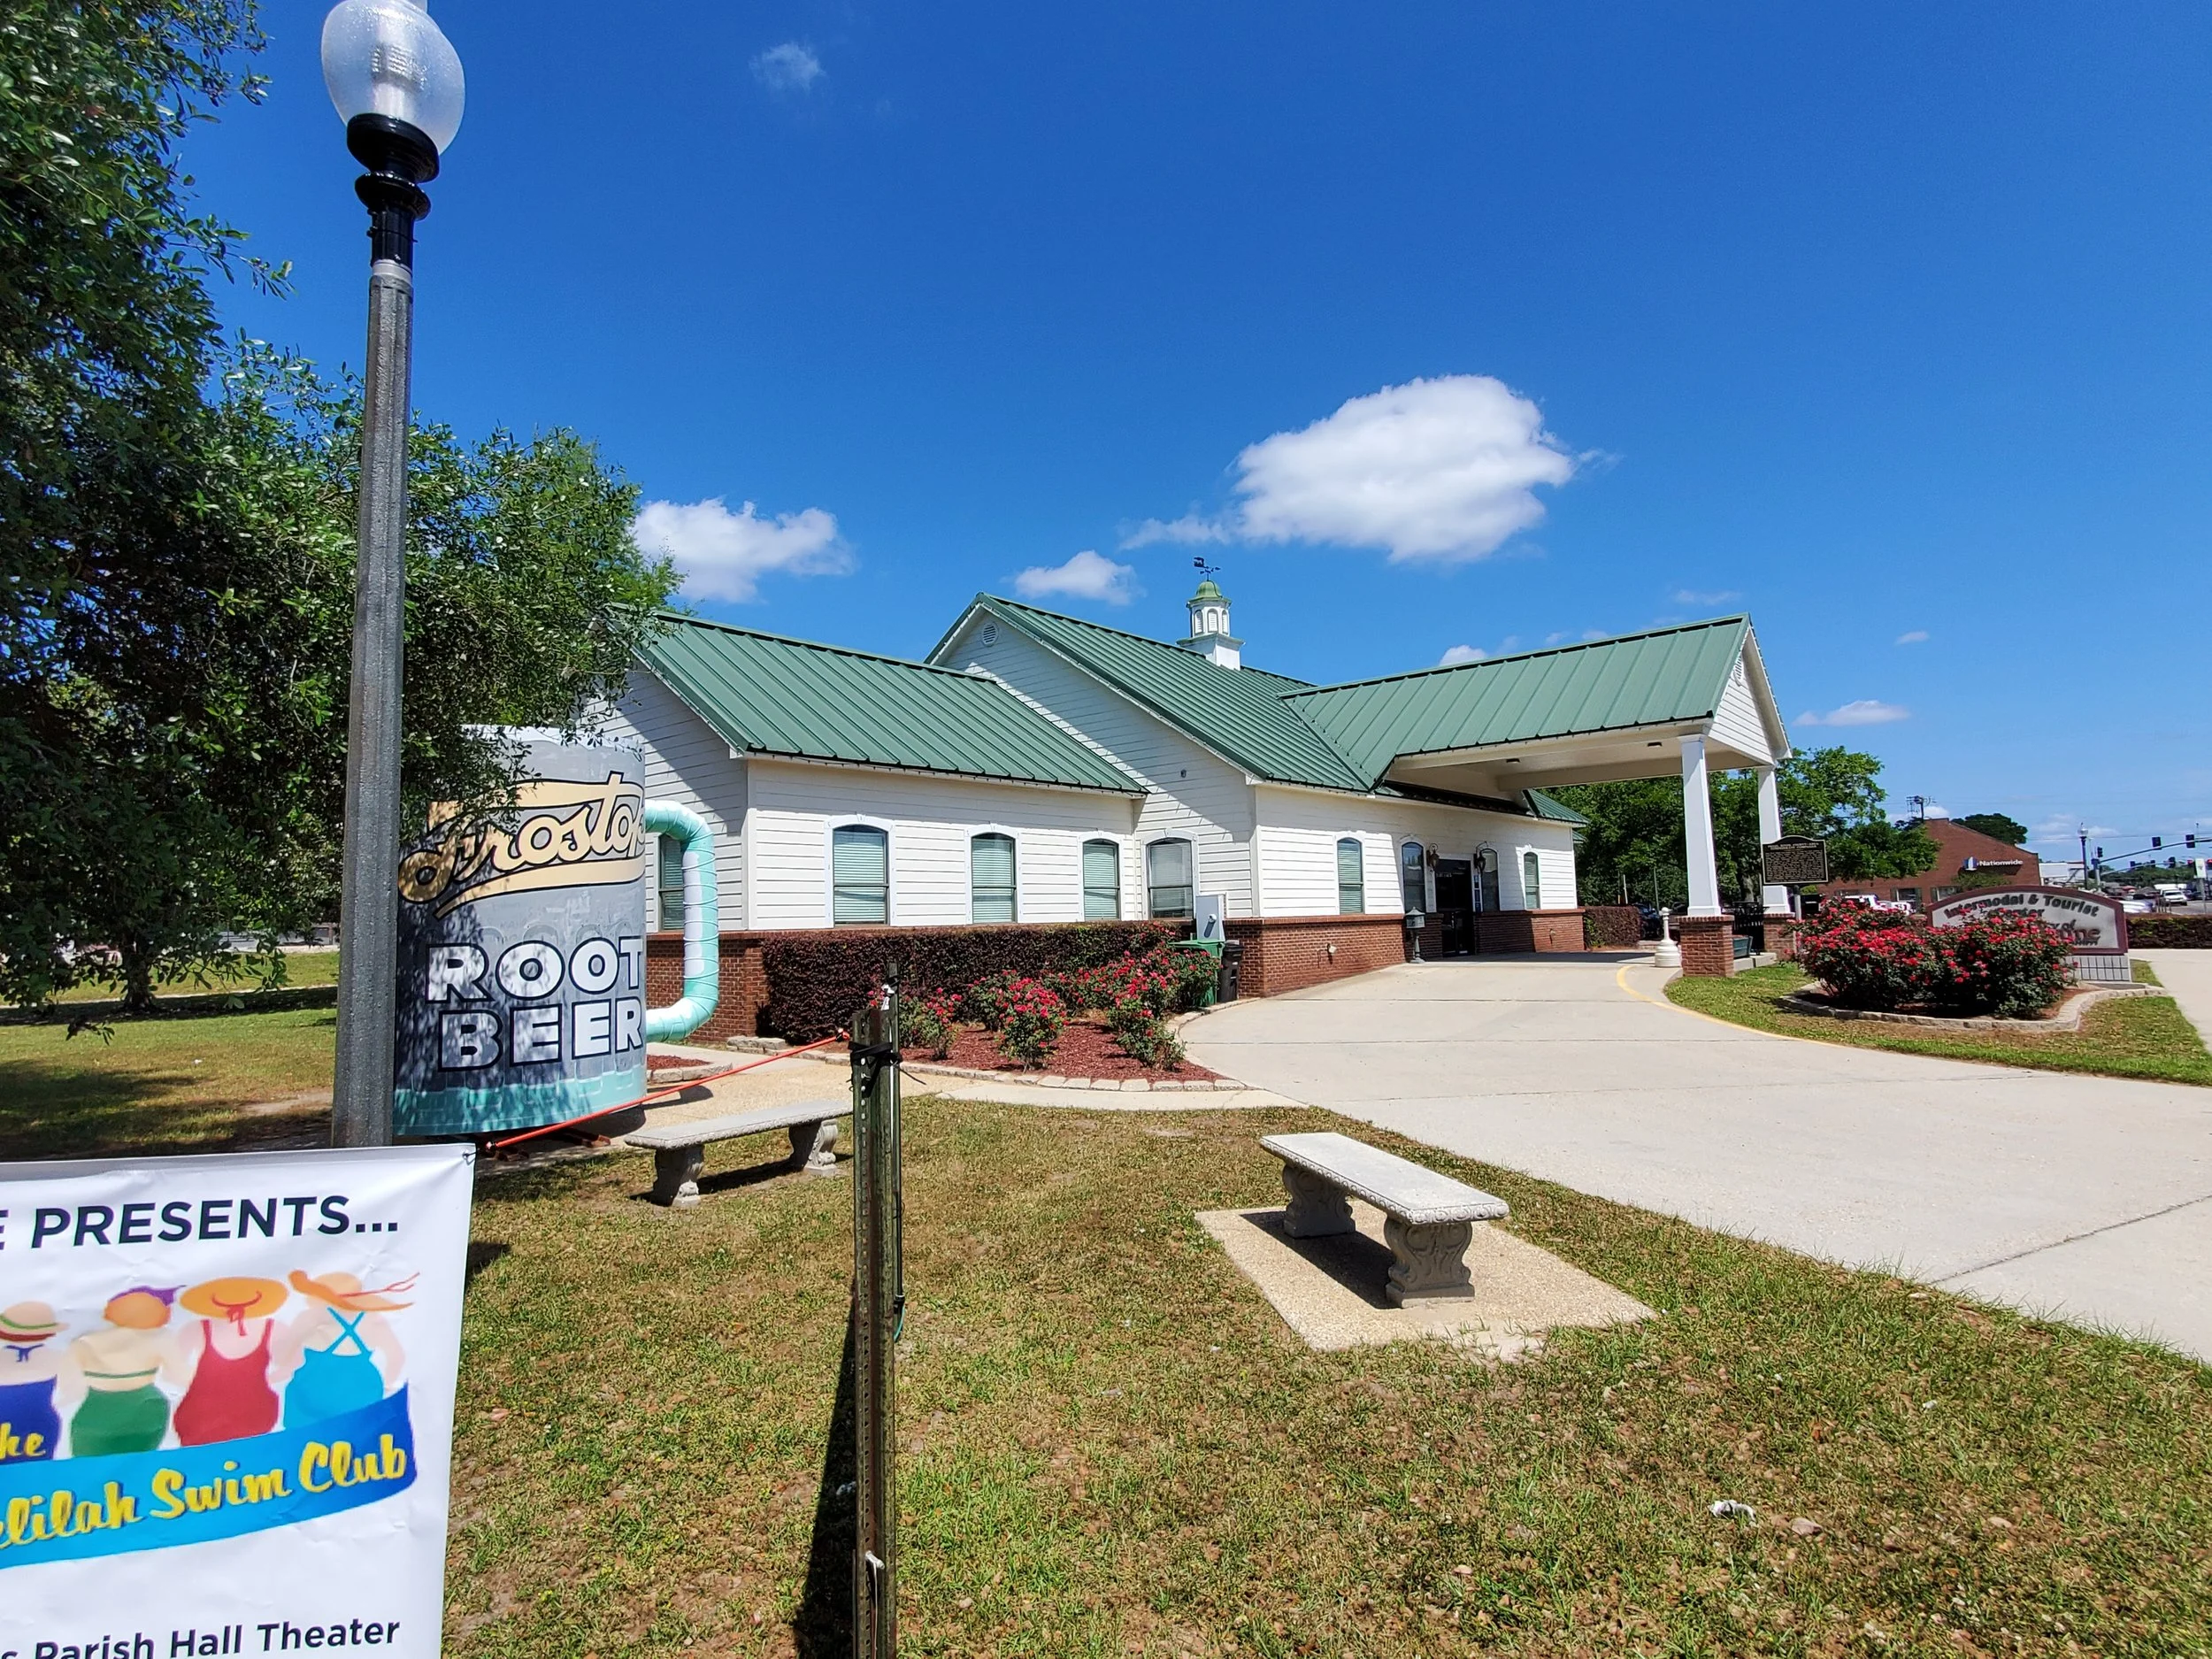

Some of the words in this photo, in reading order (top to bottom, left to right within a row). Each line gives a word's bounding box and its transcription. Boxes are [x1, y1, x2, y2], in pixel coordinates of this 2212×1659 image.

[2028, 894, 2039, 904] &
[2043, 895, 2101, 918] Tourist
[426, 936, 644, 1003] ROOT
[438, 996, 644, 1072] BEER
[31, 1194, 399, 1249] PRESENTS...
[0, 1422, 46, 1459] he
[0, 1480, 142, 1548] lilah
[150, 1461, 293, 1519] Swim
[298, 1433, 408, 1493] Club
[35, 1632, 154, 1659] Parish
[170, 1624, 243, 1657] Hall
[257, 1617, 401, 1650] Theater
